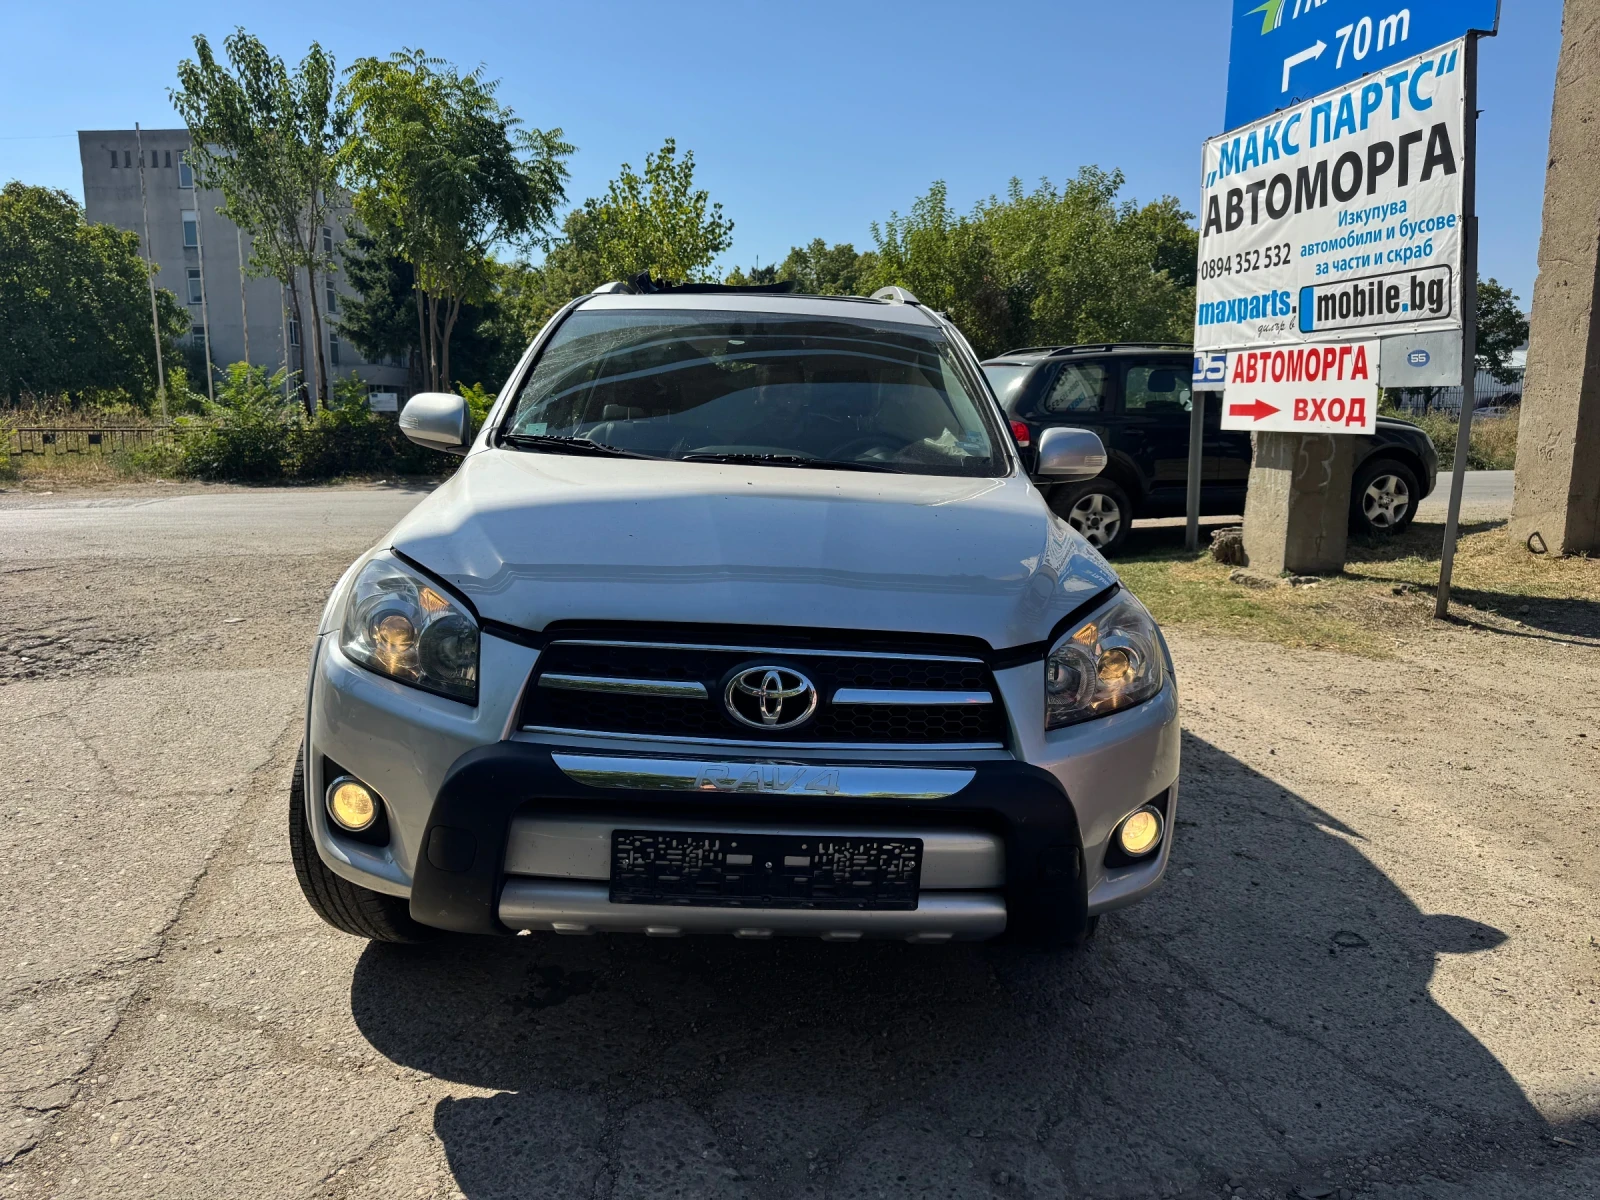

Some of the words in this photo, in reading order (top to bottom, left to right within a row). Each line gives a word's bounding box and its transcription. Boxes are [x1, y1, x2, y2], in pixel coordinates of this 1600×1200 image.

[1335, 16, 1373, 69] 70
[1203, 122, 1457, 238] АВТОМОРГА
[1338, 200, 1407, 227] Изкупува
[1300, 230, 1382, 257] автомобили
[1386, 226, 1395, 240] и
[1399, 213, 1456, 240] бусове
[1201, 255, 1232, 281] 0894
[1235, 249, 1260, 275] 352
[1264, 242, 1291, 269] 532
[1315, 262, 1329, 276] за
[1332, 253, 1370, 273] части
[1374, 252, 1383, 265] и
[1386, 238, 1433, 265] скраб
[1317, 275, 1444, 322] mobile.bg
[1232, 345, 1369, 384] АВТОМОРГА
[1293, 397, 1366, 428] ВХОД
[694, 764, 840, 795] RAV4
